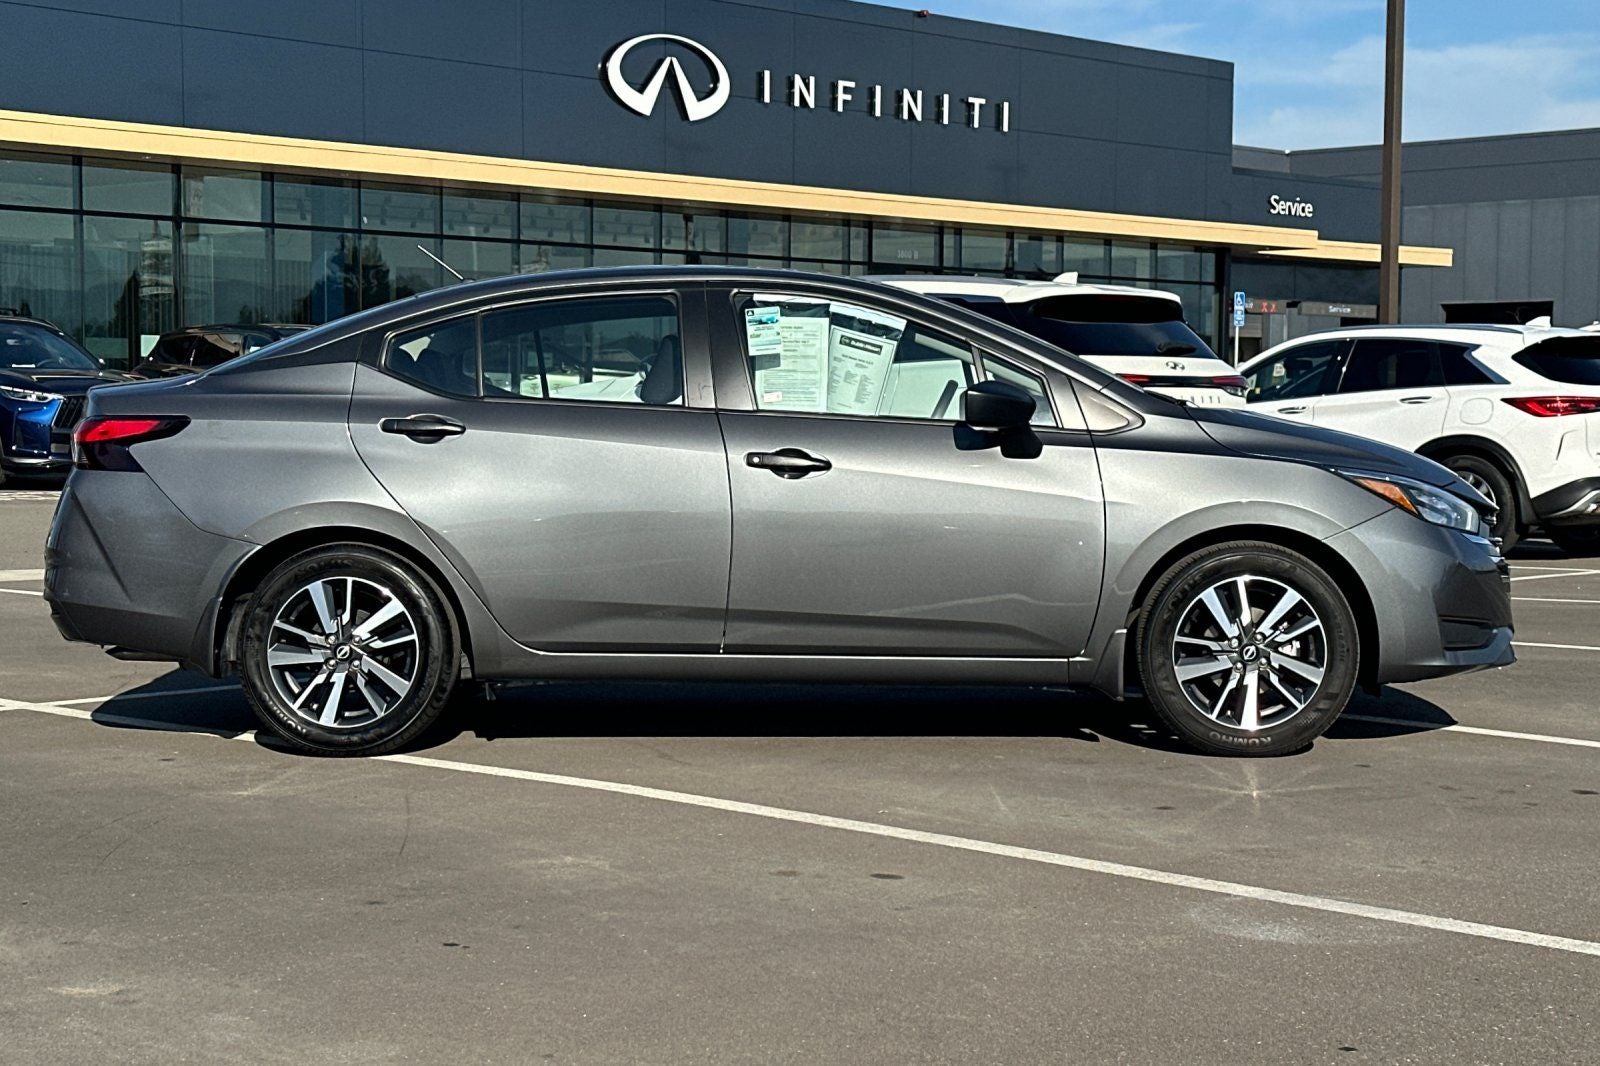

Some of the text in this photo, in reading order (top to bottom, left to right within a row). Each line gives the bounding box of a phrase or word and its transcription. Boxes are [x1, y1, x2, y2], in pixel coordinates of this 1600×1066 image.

[762, 70, 1009, 132] INFINITI
[1269, 194, 1314, 217] Service
[1209, 731, 1272, 745] KUMHO
